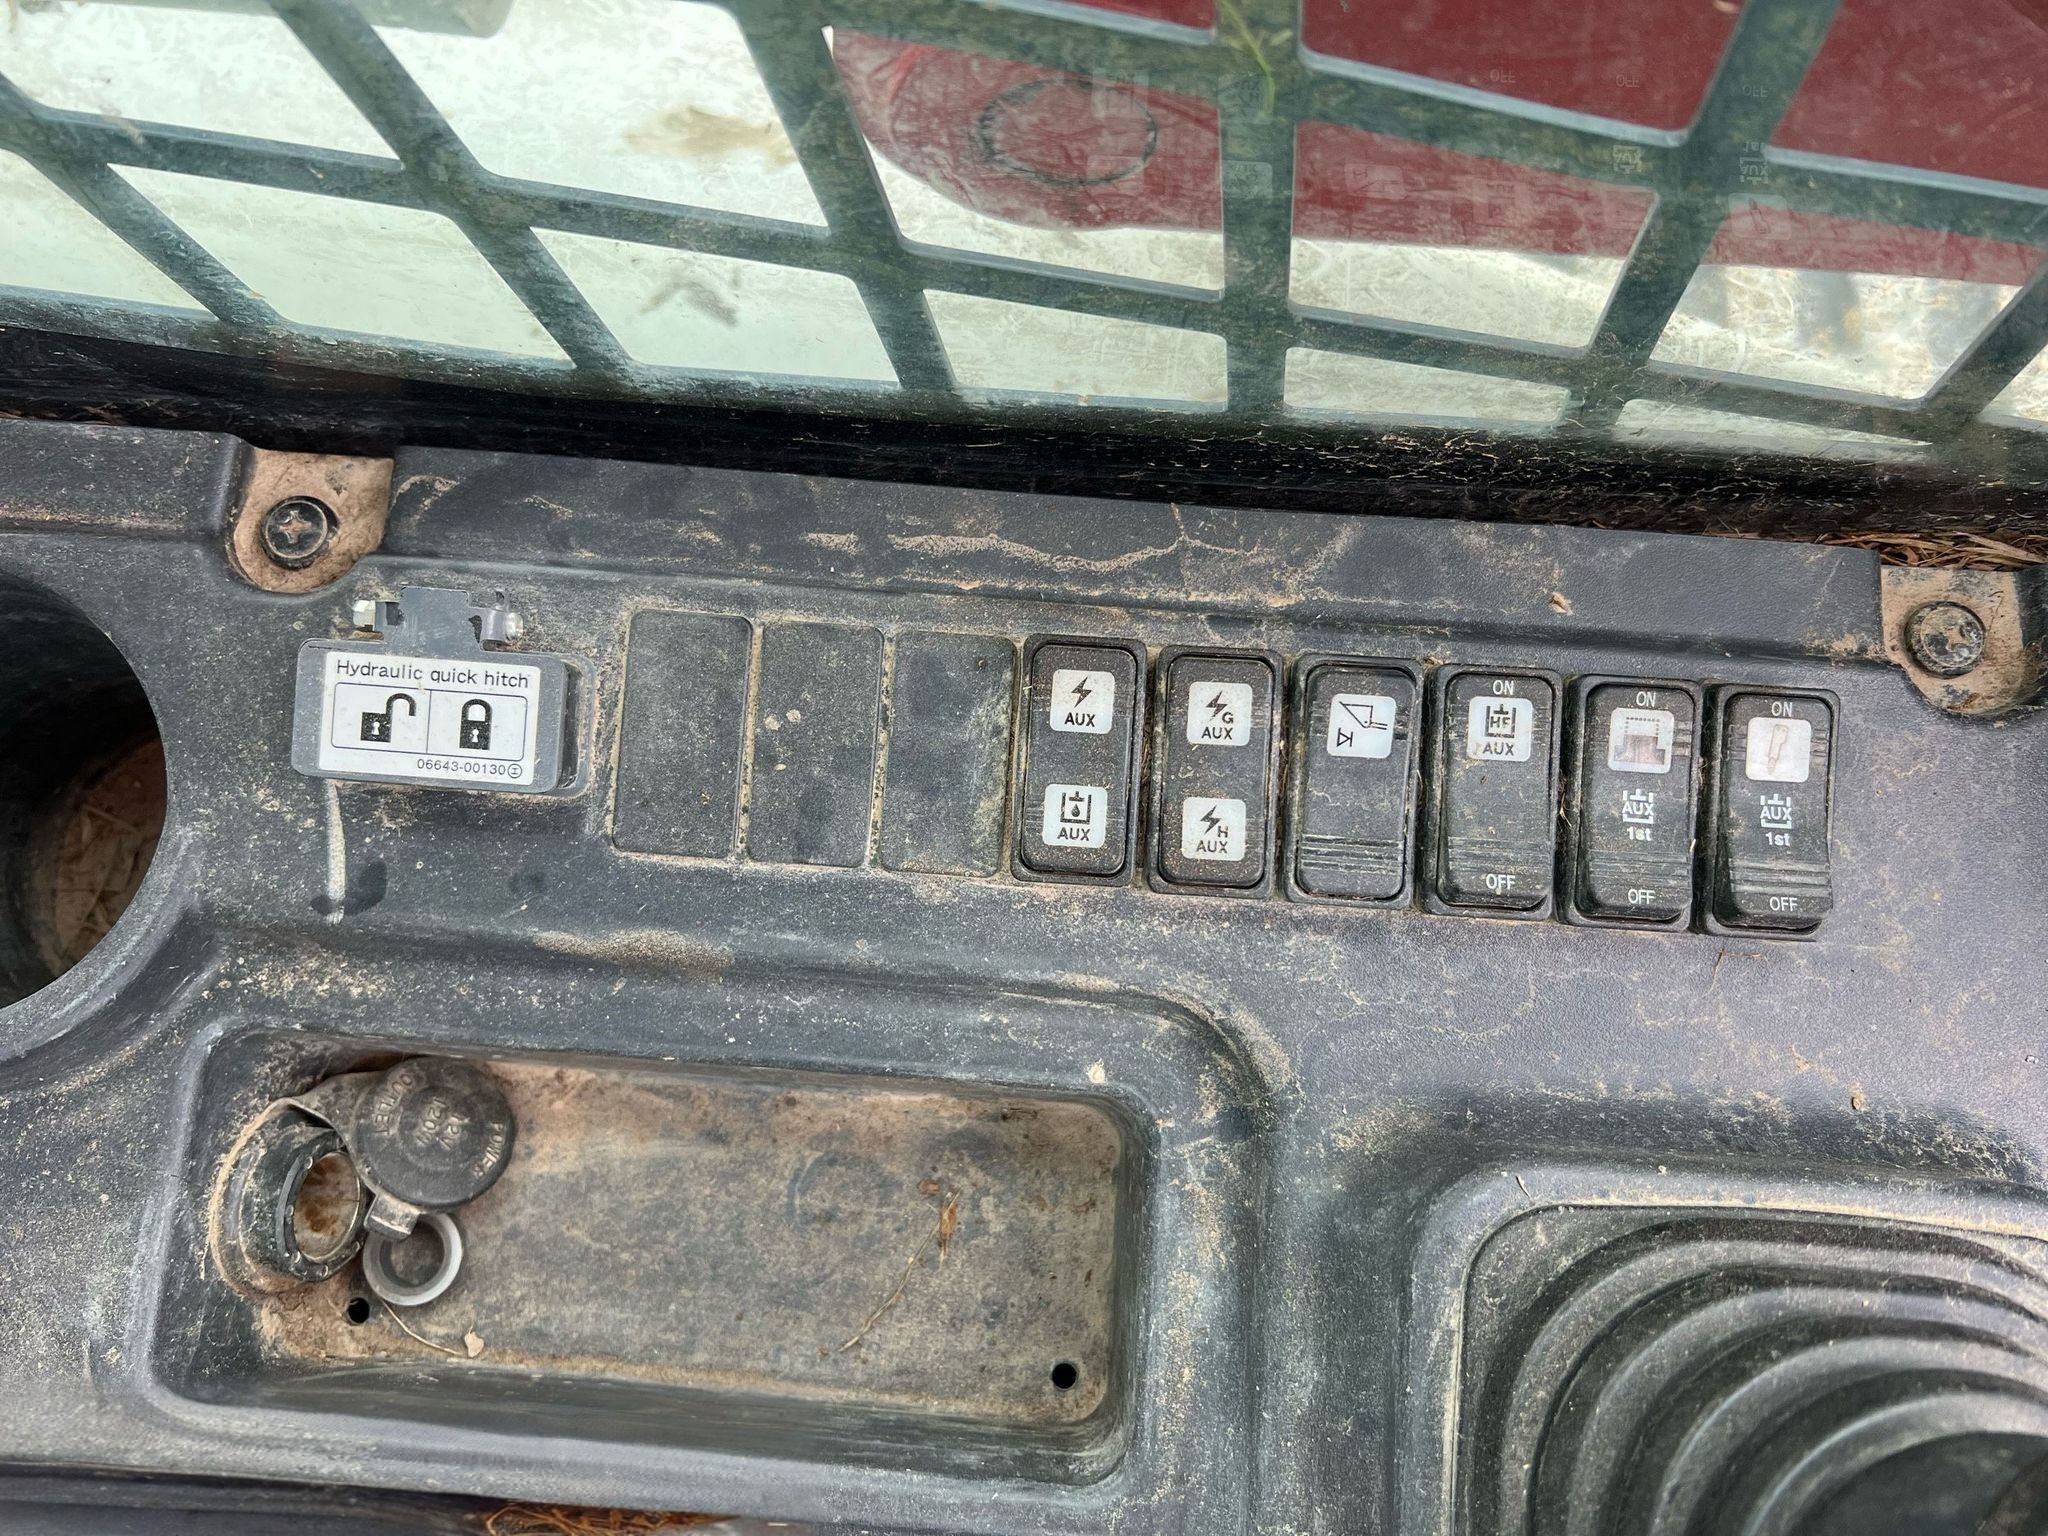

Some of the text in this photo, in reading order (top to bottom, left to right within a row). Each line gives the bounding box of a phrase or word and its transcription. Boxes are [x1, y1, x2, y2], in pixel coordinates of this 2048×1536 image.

[337, 659, 529, 688] Hydraulic quick hitch
[1492, 680, 1515, 696] ON
[1636, 692, 1657, 708] ON
[1771, 702, 1793, 717] ON
[1064, 712, 1096, 728] AUX
[1222, 712, 1234, 725] G
[1201, 727, 1233, 740] AUX
[1482, 743, 1515, 756] AUX
[1622, 803, 1655, 816] AUX
[1760, 808, 1793, 821] AUX
[1057, 828, 1091, 842] AUX
[1627, 827, 1652, 841] 1st
[1765, 832, 1791, 846] 1st
[1196, 840, 1229, 854] AUX
[1486, 874, 1516, 890] OFF
[1628, 889, 1656, 905] OFF
[1769, 896, 1798, 912] OFF
[374, 1074, 414, 1136] OUTLET
[474, 1122, 505, 1177] POWER
